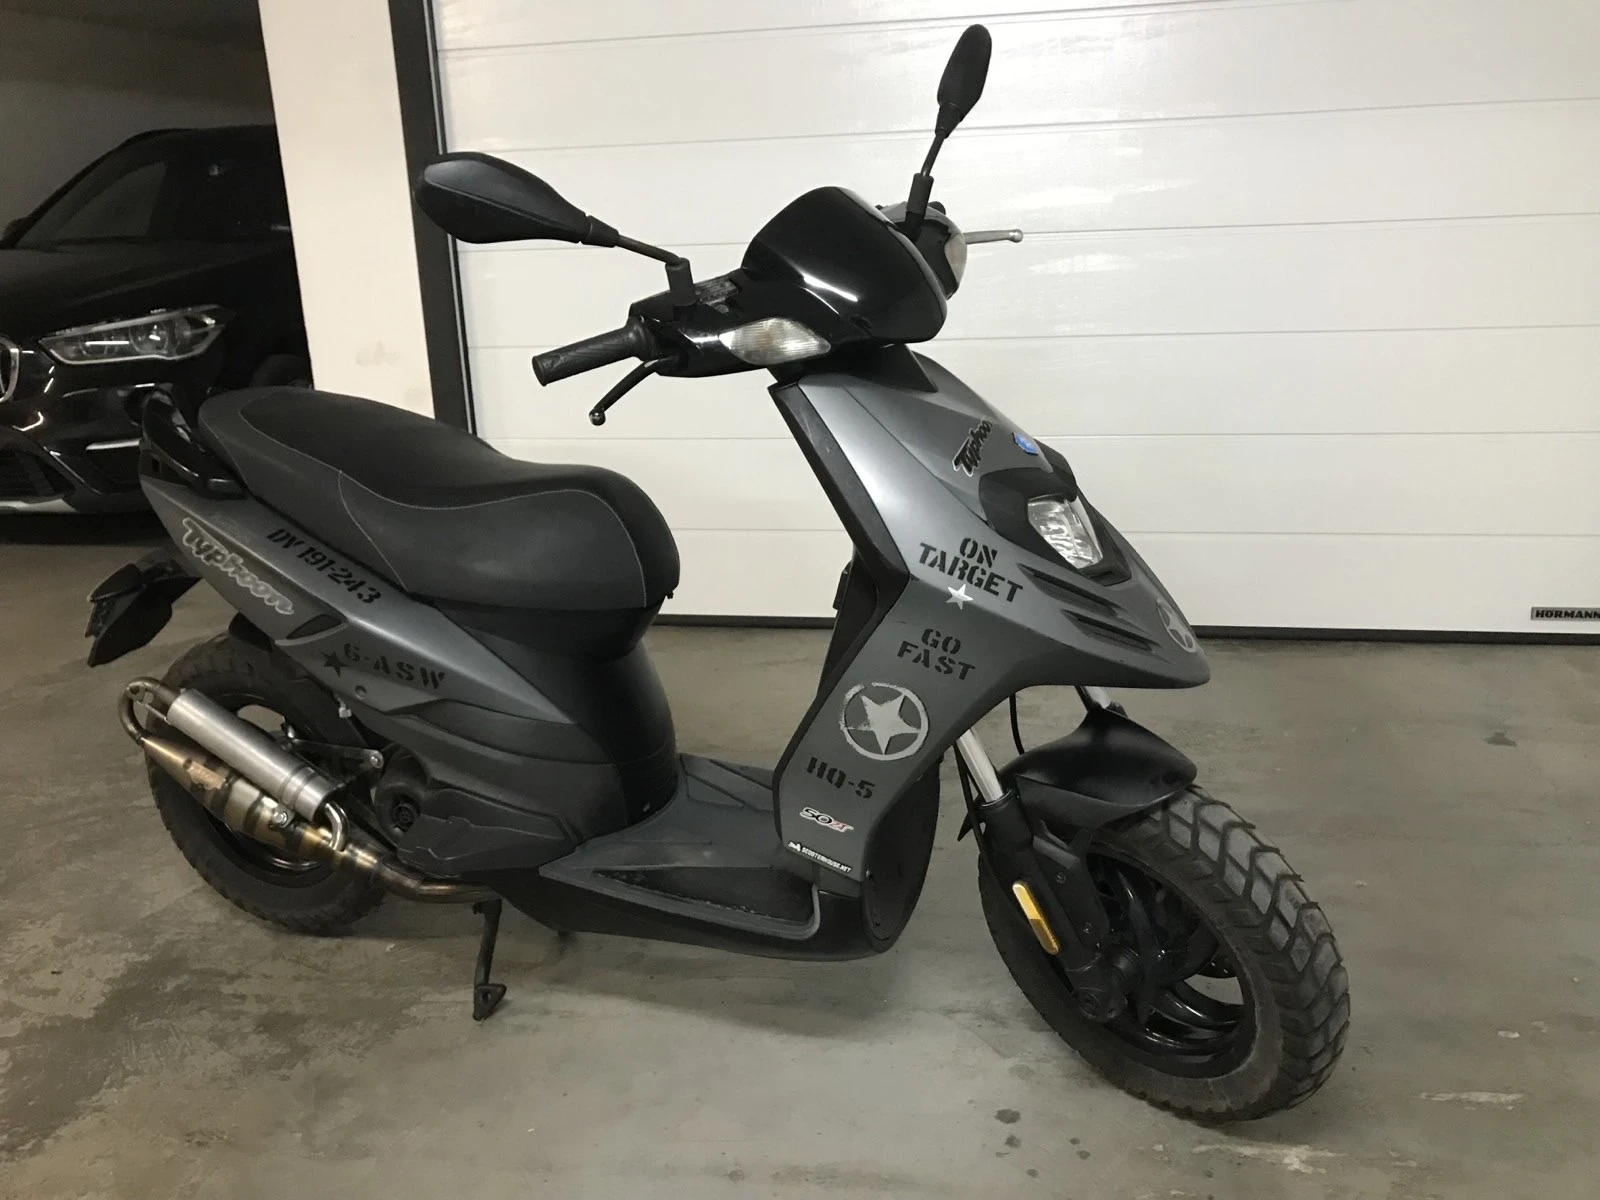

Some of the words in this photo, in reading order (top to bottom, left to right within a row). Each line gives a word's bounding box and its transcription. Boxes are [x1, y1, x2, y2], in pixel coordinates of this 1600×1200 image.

[183, 517, 294, 615] Typhoon
[266, 529, 304, 549] DV
[297, 547, 381, 603] 191-243
[919, 542, 1023, 602] TARGET
[959, 538, 997, 568] ON
[897, 640, 976, 680] FAST
[921, 628, 961, 654] GO
[344, 643, 445, 689] 6-ASW
[807, 756, 875, 799] HQ-5
